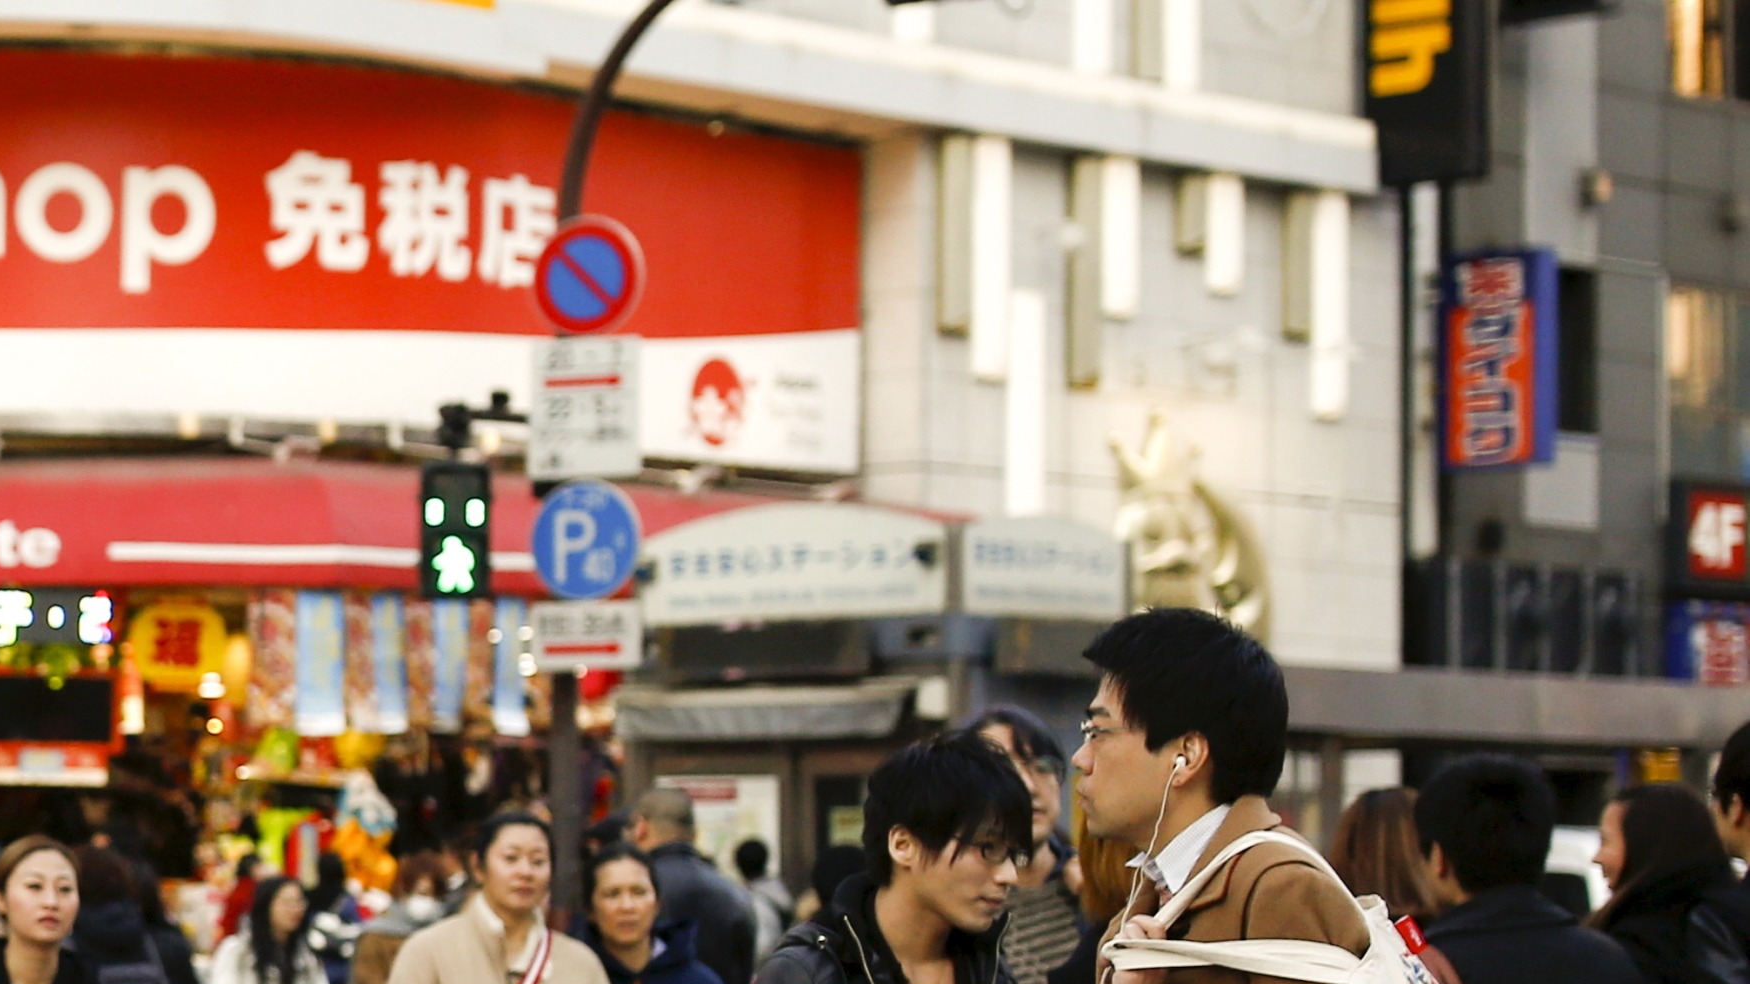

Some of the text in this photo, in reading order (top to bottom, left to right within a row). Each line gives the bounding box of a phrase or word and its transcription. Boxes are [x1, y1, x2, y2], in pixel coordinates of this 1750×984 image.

[264, 150, 558, 289] 免税店
[553, 509, 598, 586] P
[1689, 501, 1745, 569] 4F
